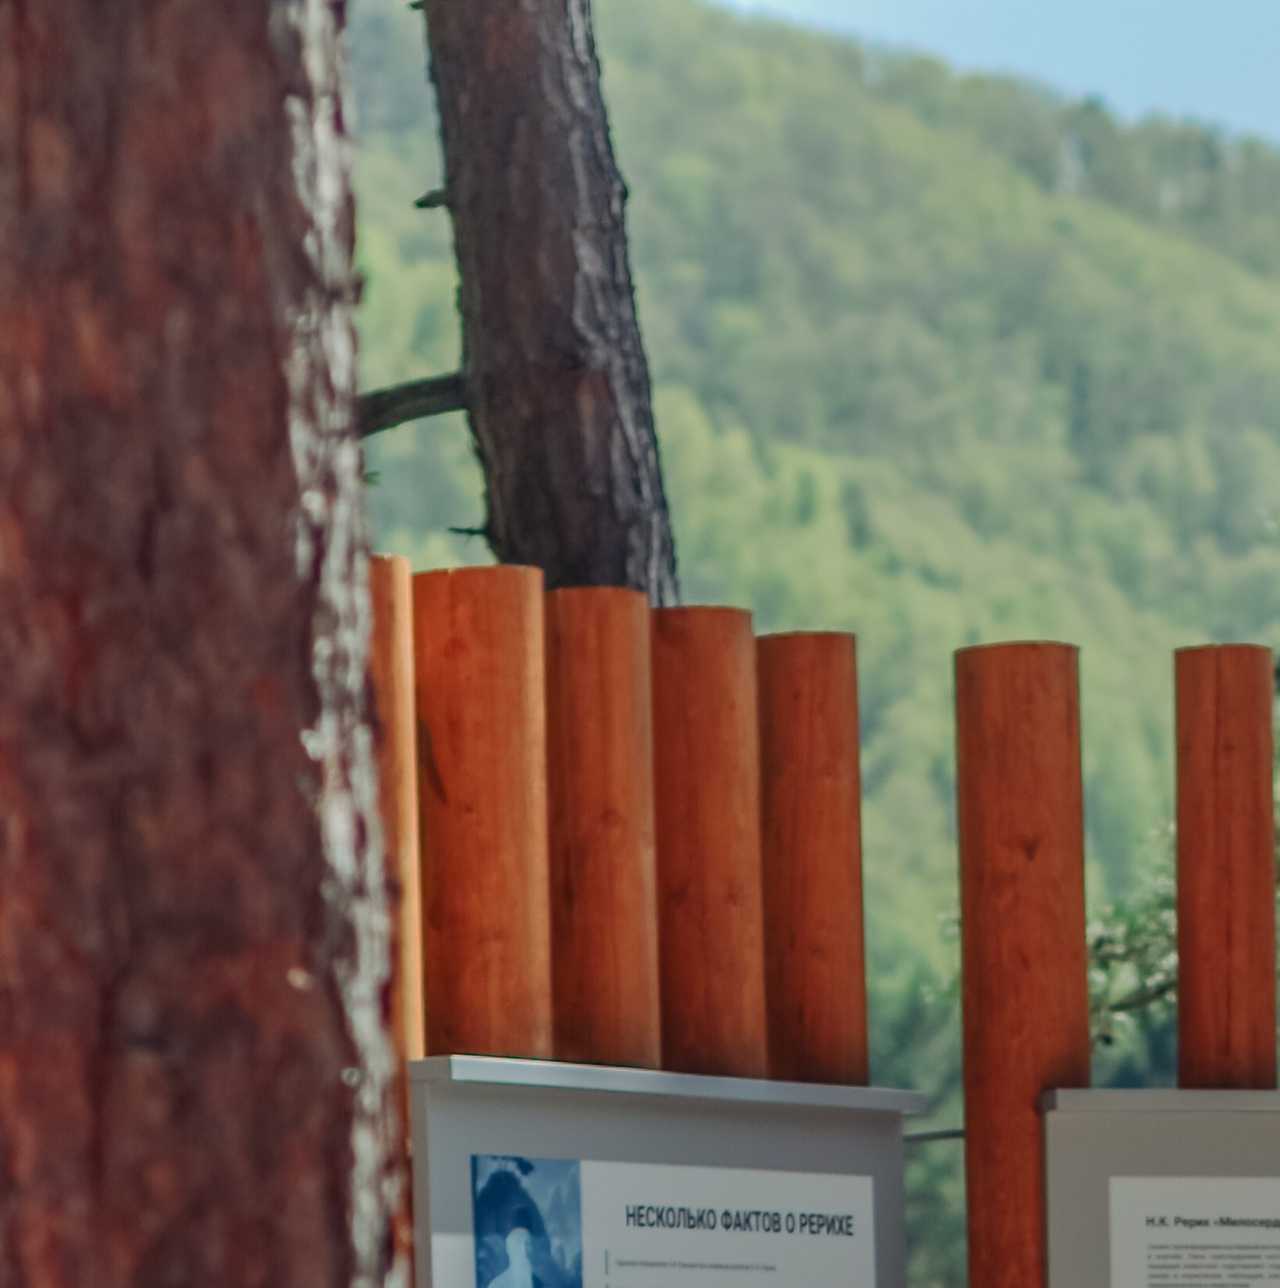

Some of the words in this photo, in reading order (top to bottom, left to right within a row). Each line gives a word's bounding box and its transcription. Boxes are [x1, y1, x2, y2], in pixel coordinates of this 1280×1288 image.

[626, 1205, 717, 1230] НЕСКОЛЬКО
[721, 1210, 780, 1233] ФАКТОВ
[785, 1212, 796, 1234] О
[798, 1213, 854, 1236] РЕРИХЕ
[1173, 1216, 1210, 1230] Рерих
